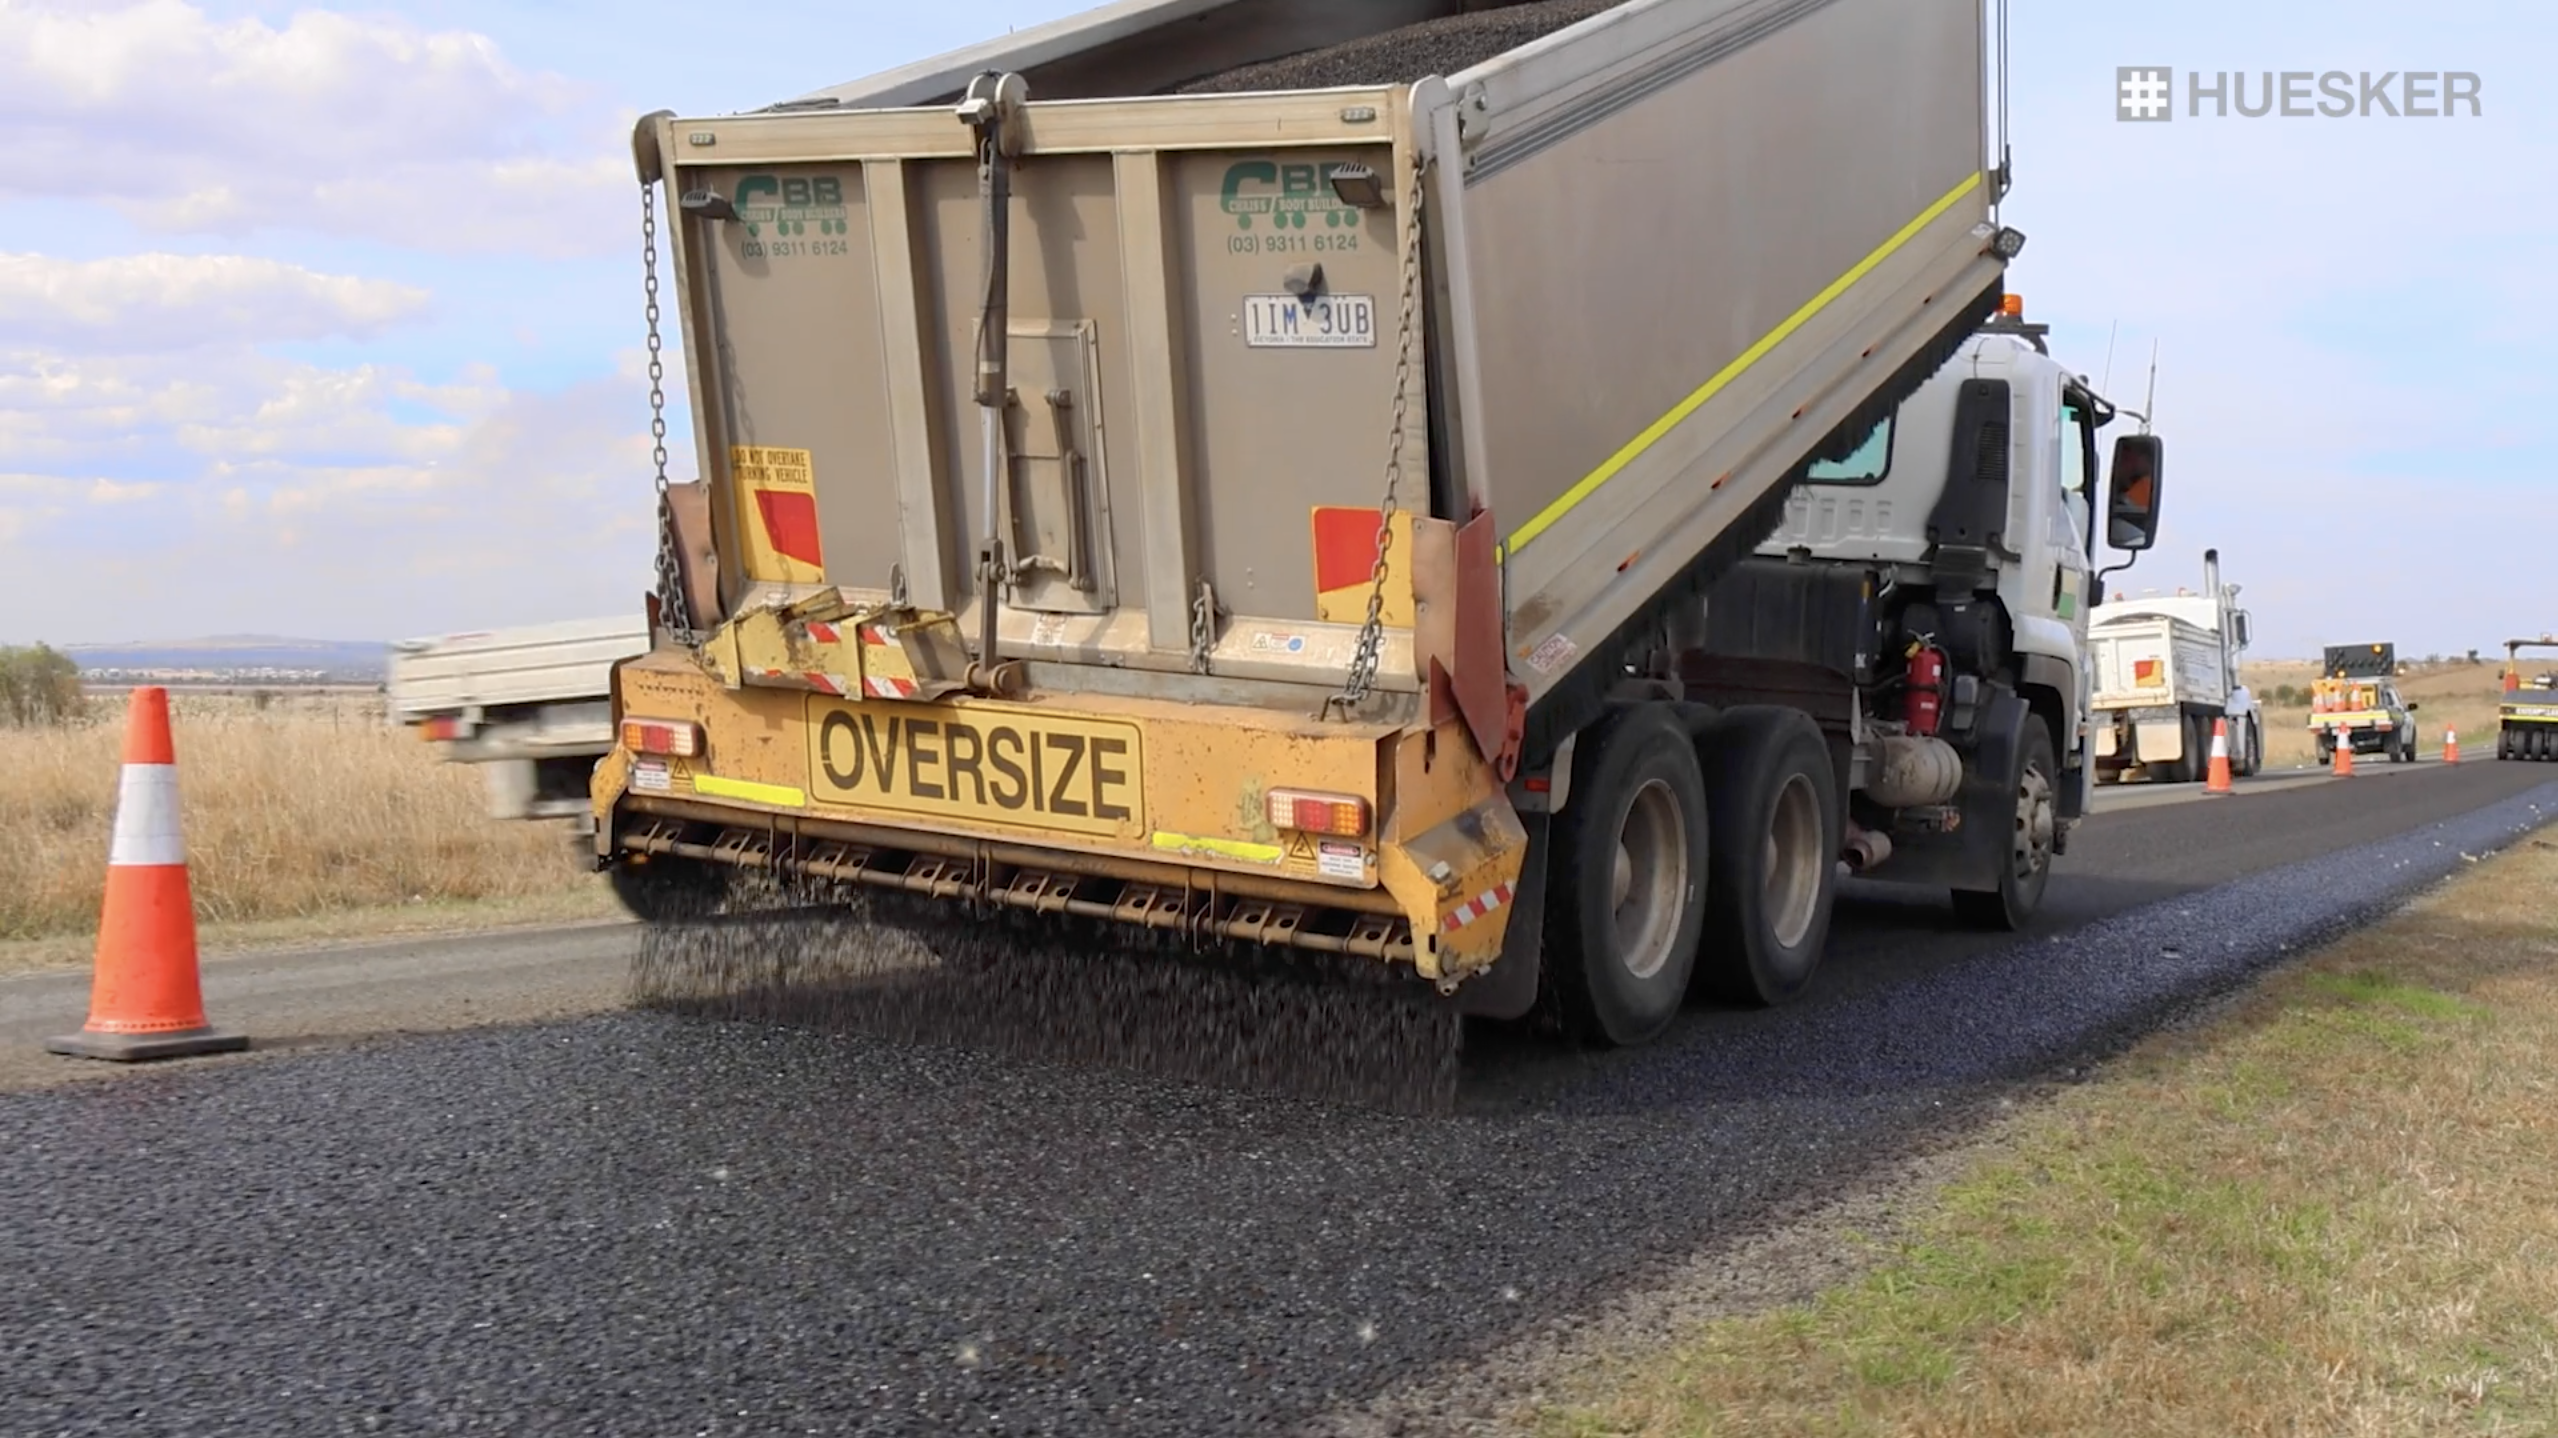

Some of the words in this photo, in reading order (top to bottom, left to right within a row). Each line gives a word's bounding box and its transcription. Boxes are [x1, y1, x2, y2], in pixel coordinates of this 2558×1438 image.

[735, 174, 843, 220] CBB
[742, 241, 768, 259] (03)
[772, 241, 806, 257] 9311
[812, 240, 848, 256] 6124
[1227, 234, 1260, 255] (03)
[1266, 235, 1306, 252] 9311
[1314, 234, 1358, 251] 6124
[1319, 302, 1369, 334] 3UB
[820, 709, 1132, 822] OVERSIZE
